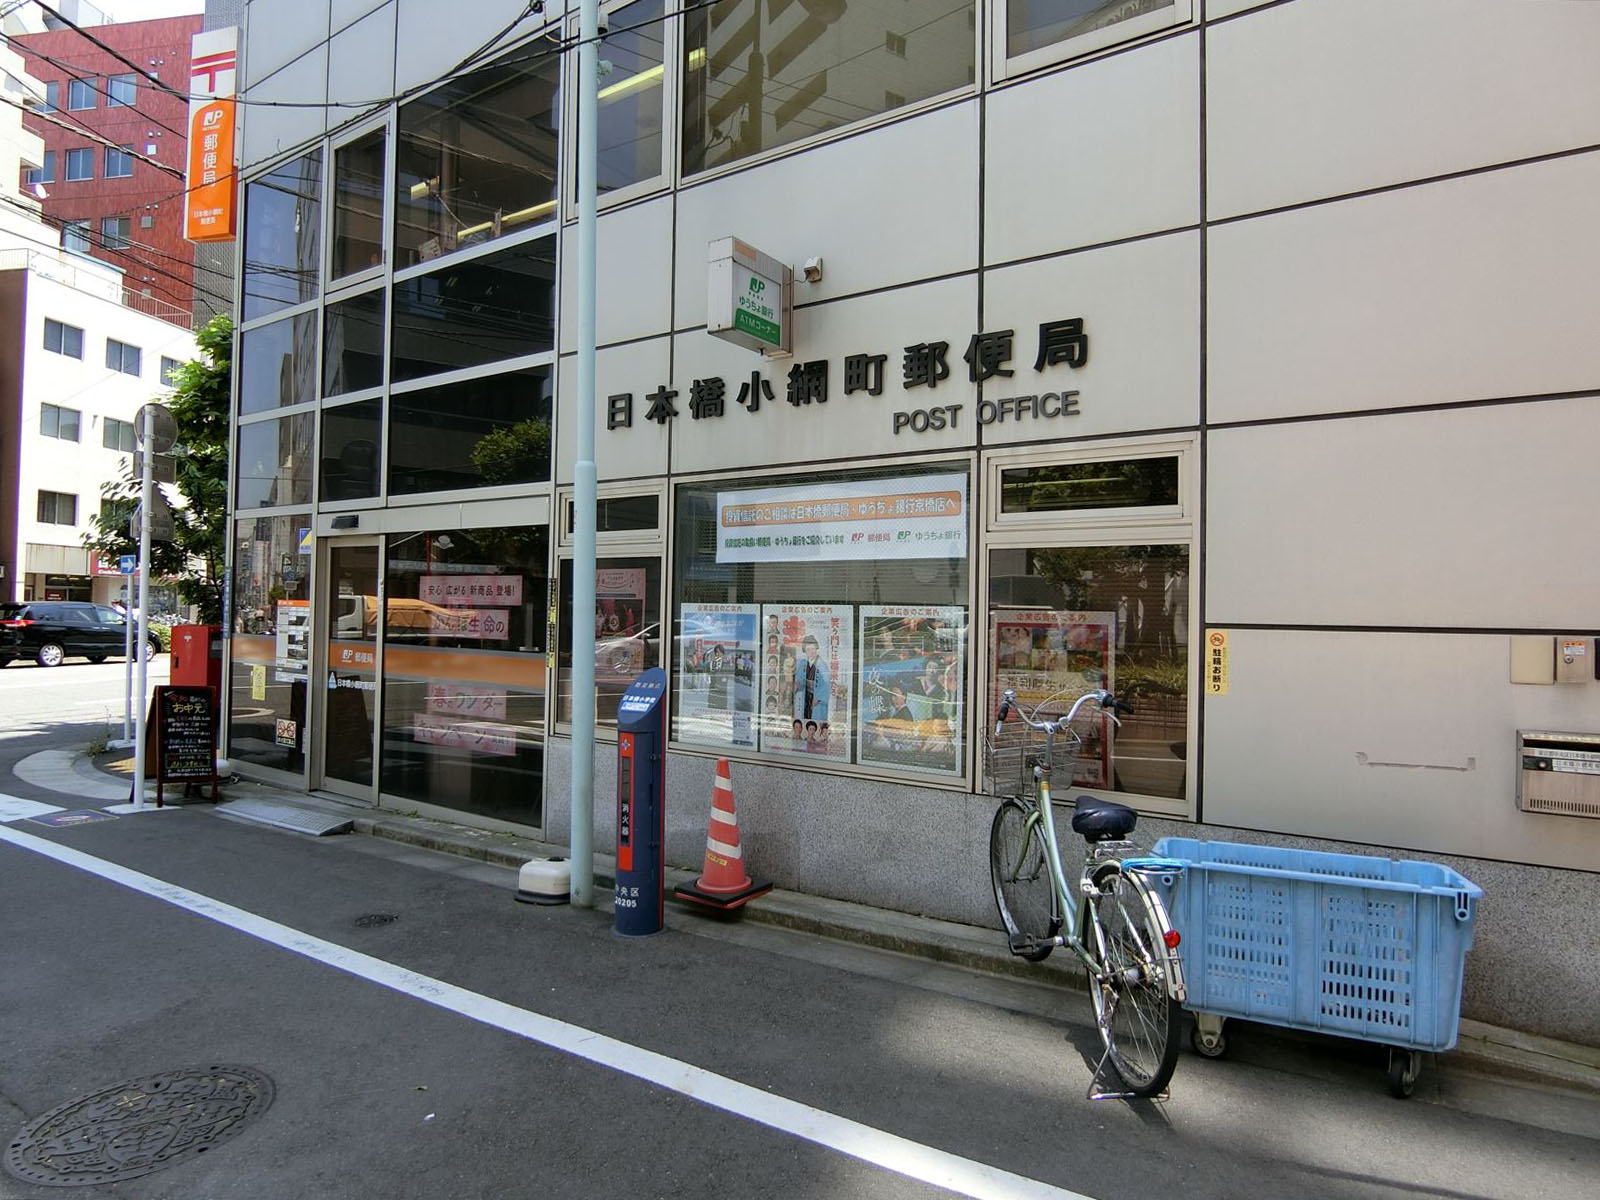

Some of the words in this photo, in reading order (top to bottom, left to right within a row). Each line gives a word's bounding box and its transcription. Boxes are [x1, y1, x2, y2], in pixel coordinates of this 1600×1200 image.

[203, 133, 218, 187] 郵便局
[739, 296, 774, 320] ゆうちょ銀行
[740, 314, 777, 334] ATMコーナー
[607, 317, 1089, 430] 日本橋小網町郵便局
[893, 404, 963, 435] POST
[976, 390, 1081, 425] OFFICE
[915, 530, 961, 541] ゆうちょ銀行
[428, 585, 442, 596] 安心
[446, 586, 466, 596] 広がる
[470, 585, 493, 596] 新商品
[1212, 648, 1222, 692] 駐輪お断り
[172, 703, 205, 713] お中元
[621, 803, 629, 835] 消火器
